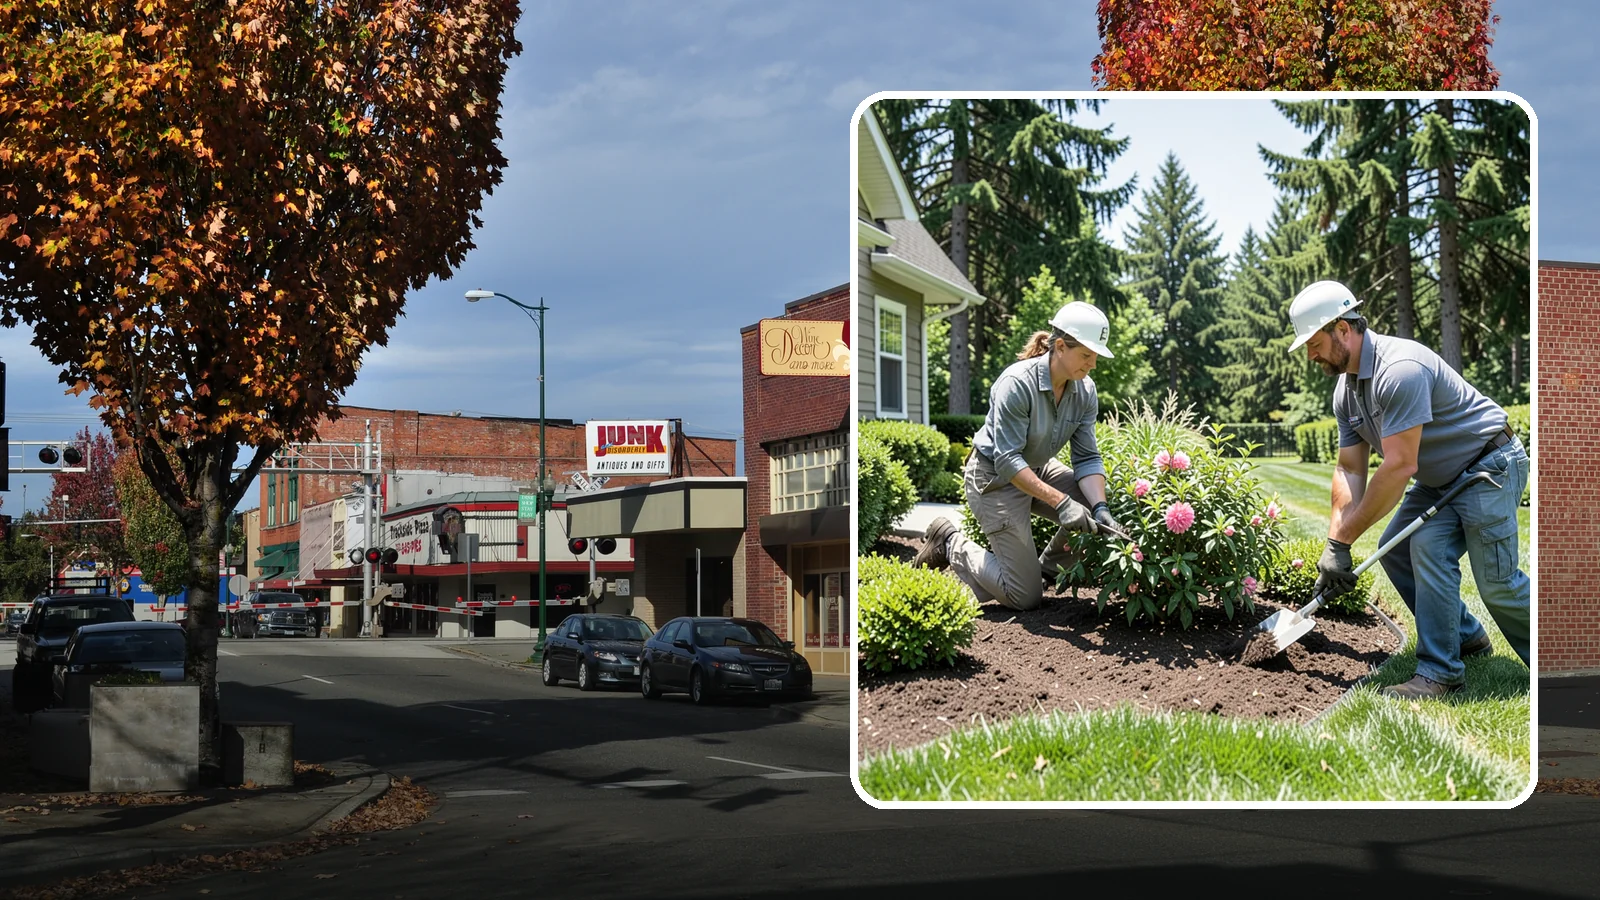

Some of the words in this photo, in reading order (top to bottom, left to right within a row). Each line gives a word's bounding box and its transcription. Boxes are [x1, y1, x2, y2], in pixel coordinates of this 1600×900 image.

[595, 425, 665, 457] JUNK
[607, 446, 646, 454] DISORDERLY
[597, 461, 628, 470] ANTIQUES
[631, 461, 644, 470] AND
[647, 460, 665, 469] GIFTS
[352, 498, 364, 511] CRO
[414, 519, 429, 535] Pizza
